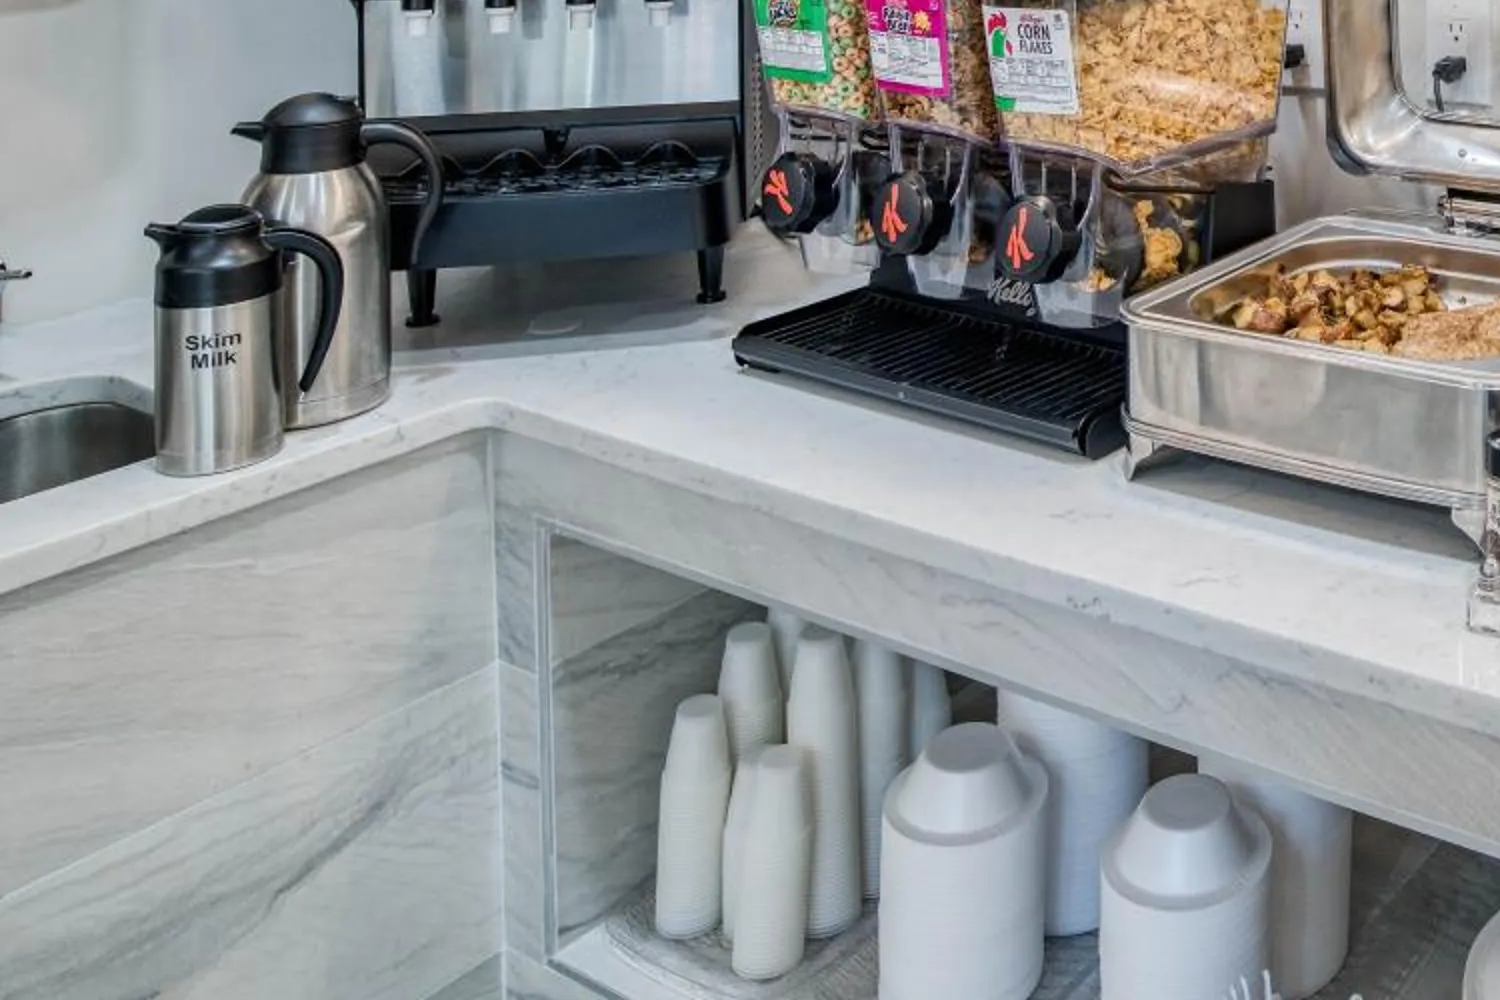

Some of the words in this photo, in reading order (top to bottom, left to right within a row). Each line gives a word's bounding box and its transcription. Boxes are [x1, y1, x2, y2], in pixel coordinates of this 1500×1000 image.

[1017, 23, 1051, 41] CORN
[1019, 39, 1053, 55] FLAKES
[881, 183, 908, 244] K
[1006, 207, 1035, 270] K
[185, 333, 242, 351] Skim
[191, 350, 237, 369] Milk
